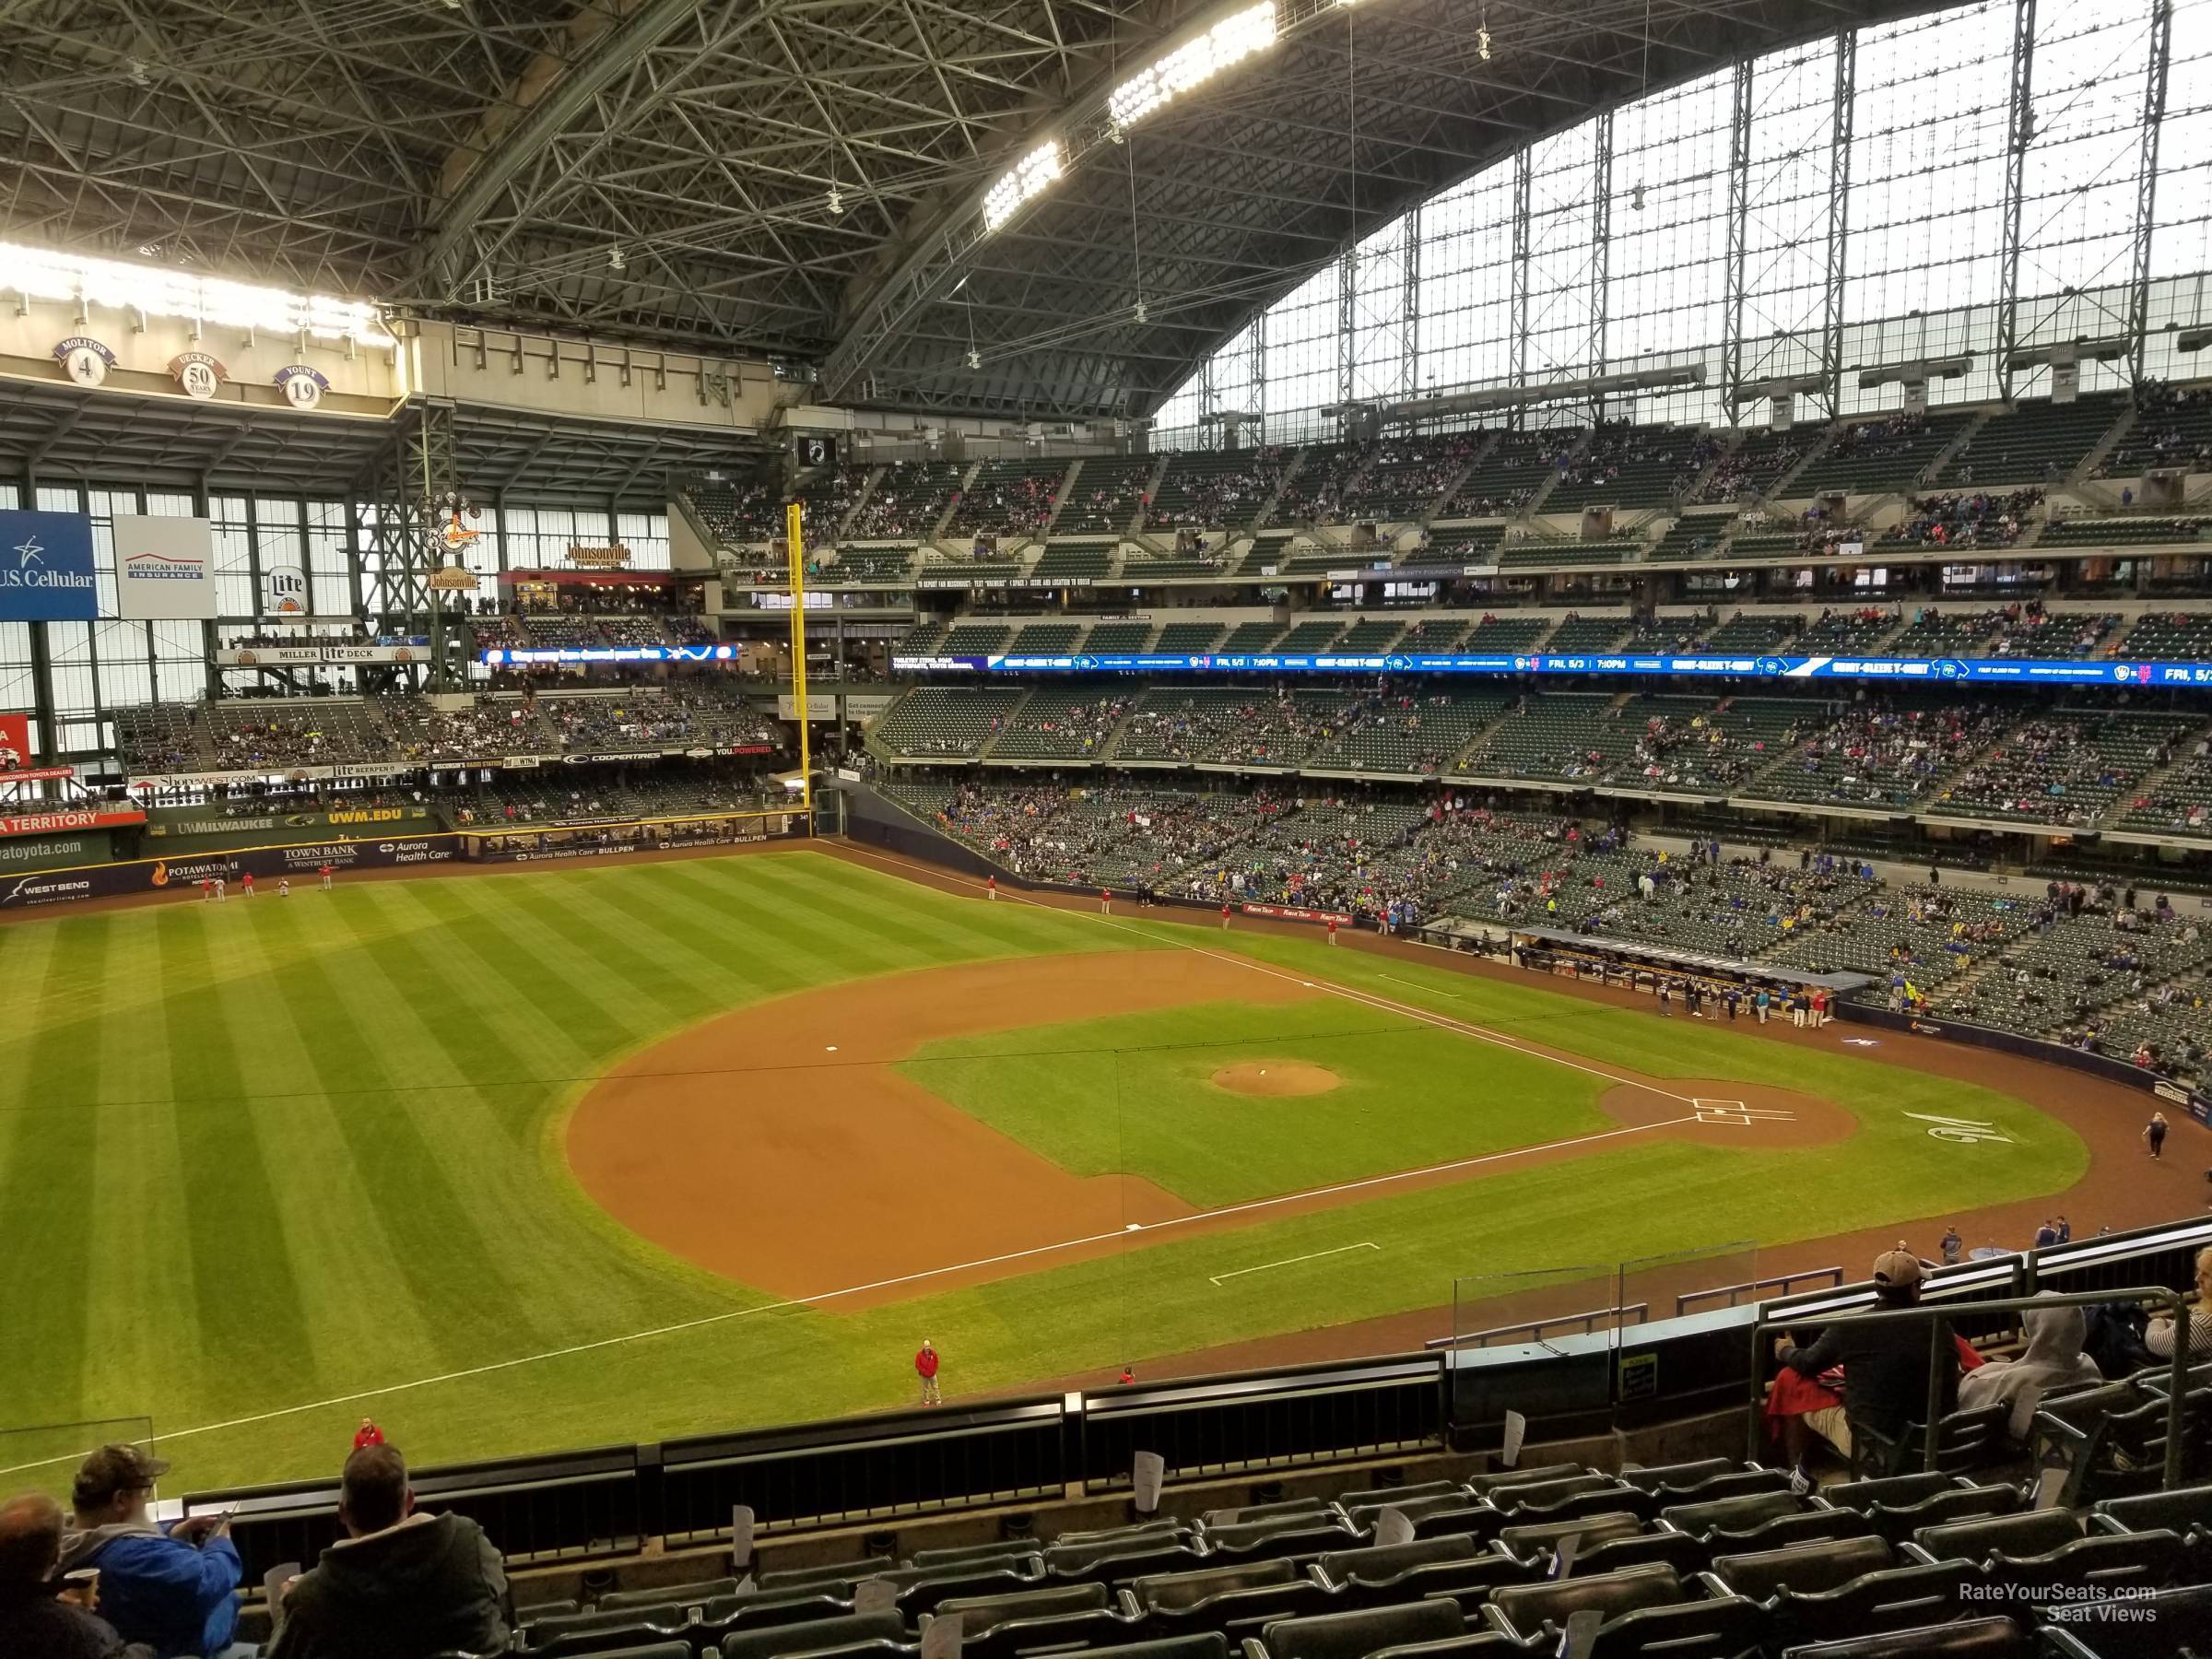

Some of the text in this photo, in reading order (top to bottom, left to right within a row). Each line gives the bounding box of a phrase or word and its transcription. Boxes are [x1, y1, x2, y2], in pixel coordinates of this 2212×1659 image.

[63, 338, 107, 356] MOLITOR
[179, 353, 214, 366] UECKER
[78, 357, 91, 378] 4
[287, 366, 317, 377] YOUNT
[190, 367, 209, 384] 50
[291, 382, 315, 402] 19
[564, 542, 631, 560] Johnsonville
[128, 563, 171, 571] AMERICAN
[272, 575, 301, 596] Lite
[431, 574, 477, 588] Johnsonville
[279, 651, 317, 659] MILLER
[2165, 668, 2191, 681] FRI,
[2194, 668, 2212, 681] 5/
[11, 812, 98, 830] TERRITORY
[328, 809, 402, 824] UWM.EDU
[396, 841, 429, 852] Aurora
[694, 838, 715, 846] Health
[734, 834, 767, 843] BULLPEN
[0, 841, 81, 861] atoyota.com
[283, 844, 359, 859] TOWN BANK
[396, 850, 451, 863] Health Care
[555, 850, 577, 858] Health
[598, 845, 635, 854] BULLPEN
[294, 859, 333, 868] WINTRUST
[25, 881, 89, 895] WEST BEND
